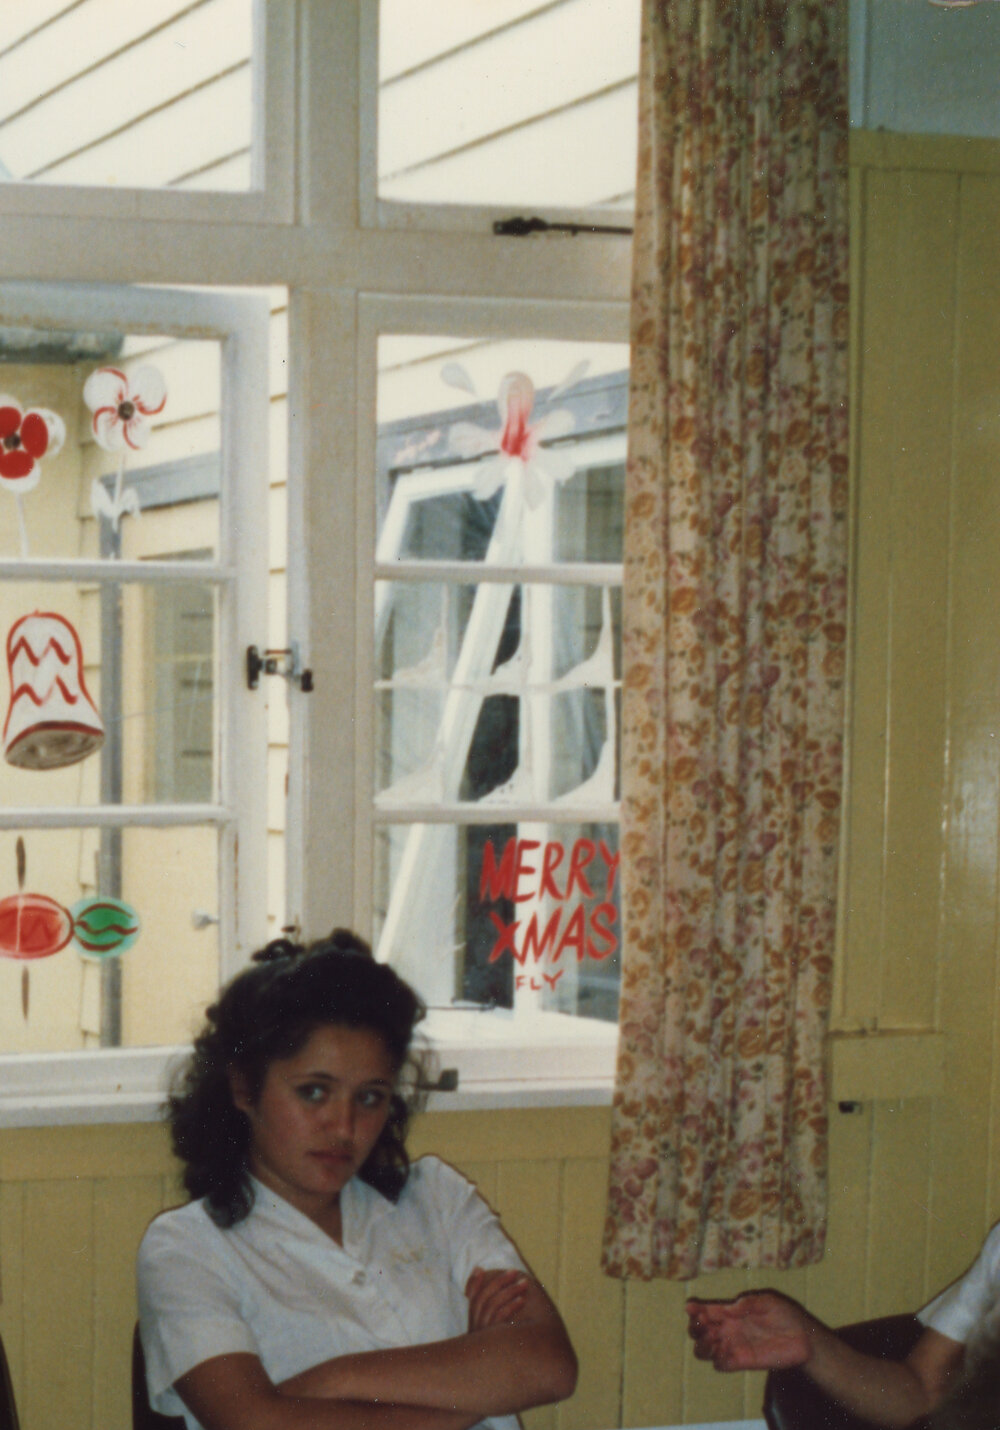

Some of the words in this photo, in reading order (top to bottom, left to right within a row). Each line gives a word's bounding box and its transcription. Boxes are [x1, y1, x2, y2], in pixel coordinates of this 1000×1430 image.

[480, 837, 620, 903] MERRY
[488, 902, 618, 966] XMAS
[515, 969, 564, 991] FLY
